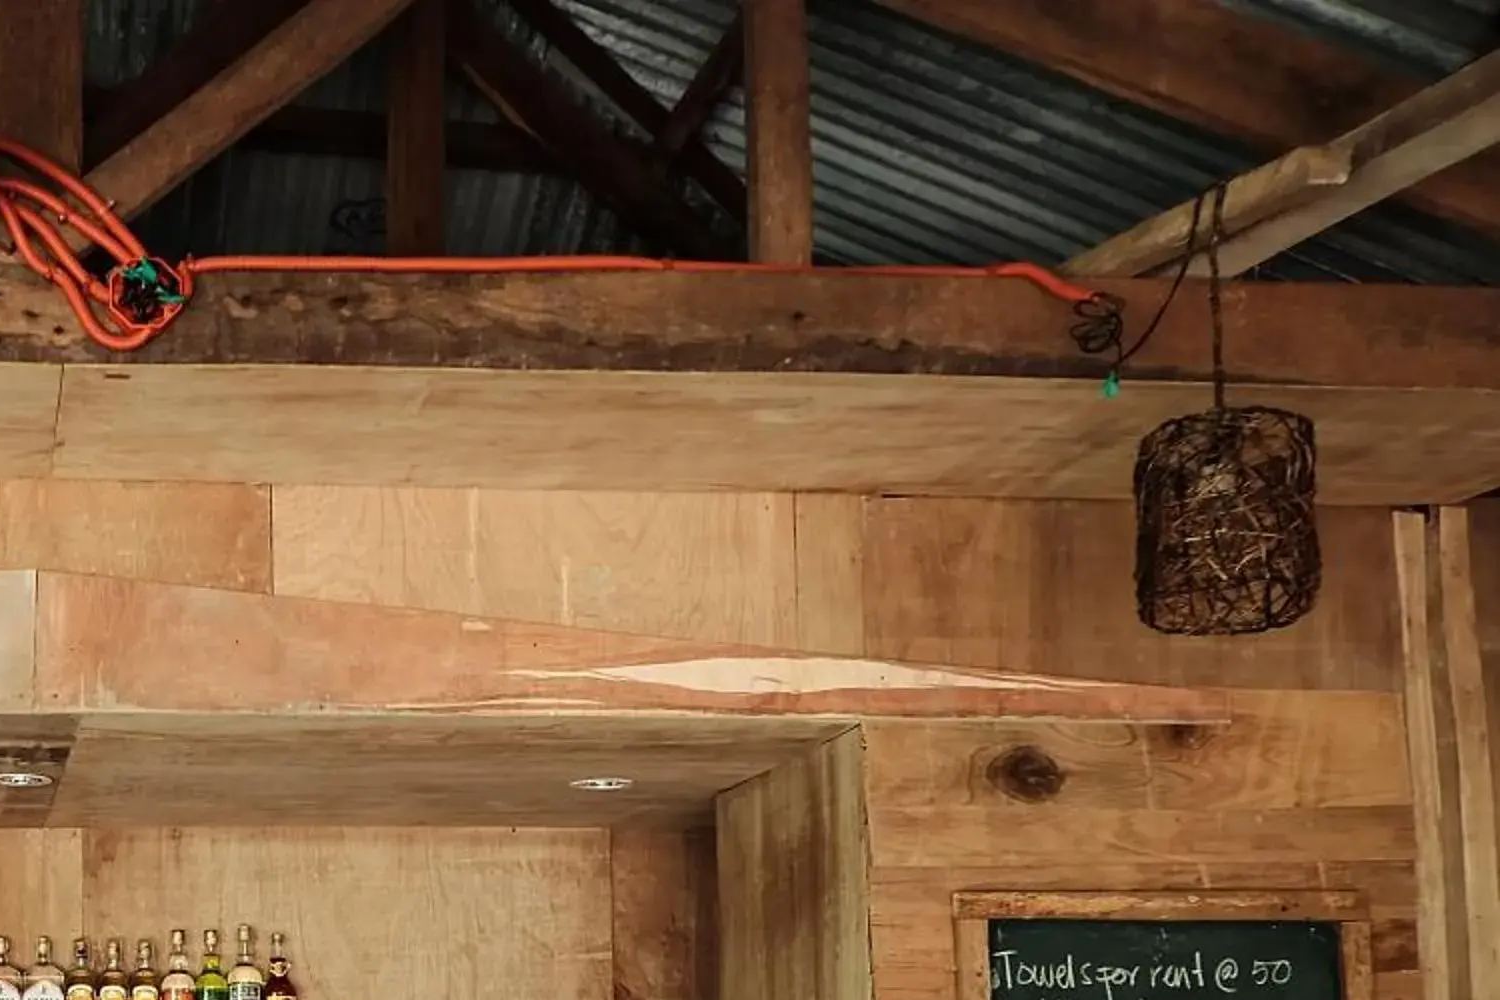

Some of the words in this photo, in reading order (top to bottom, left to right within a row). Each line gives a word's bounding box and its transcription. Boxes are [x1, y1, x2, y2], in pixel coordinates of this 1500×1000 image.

[993, 950, 1092, 990] Towels
[1150, 951, 1205, 990] rent
[1214, 957, 1240, 993] @
[1251, 959, 1293, 985] 50
